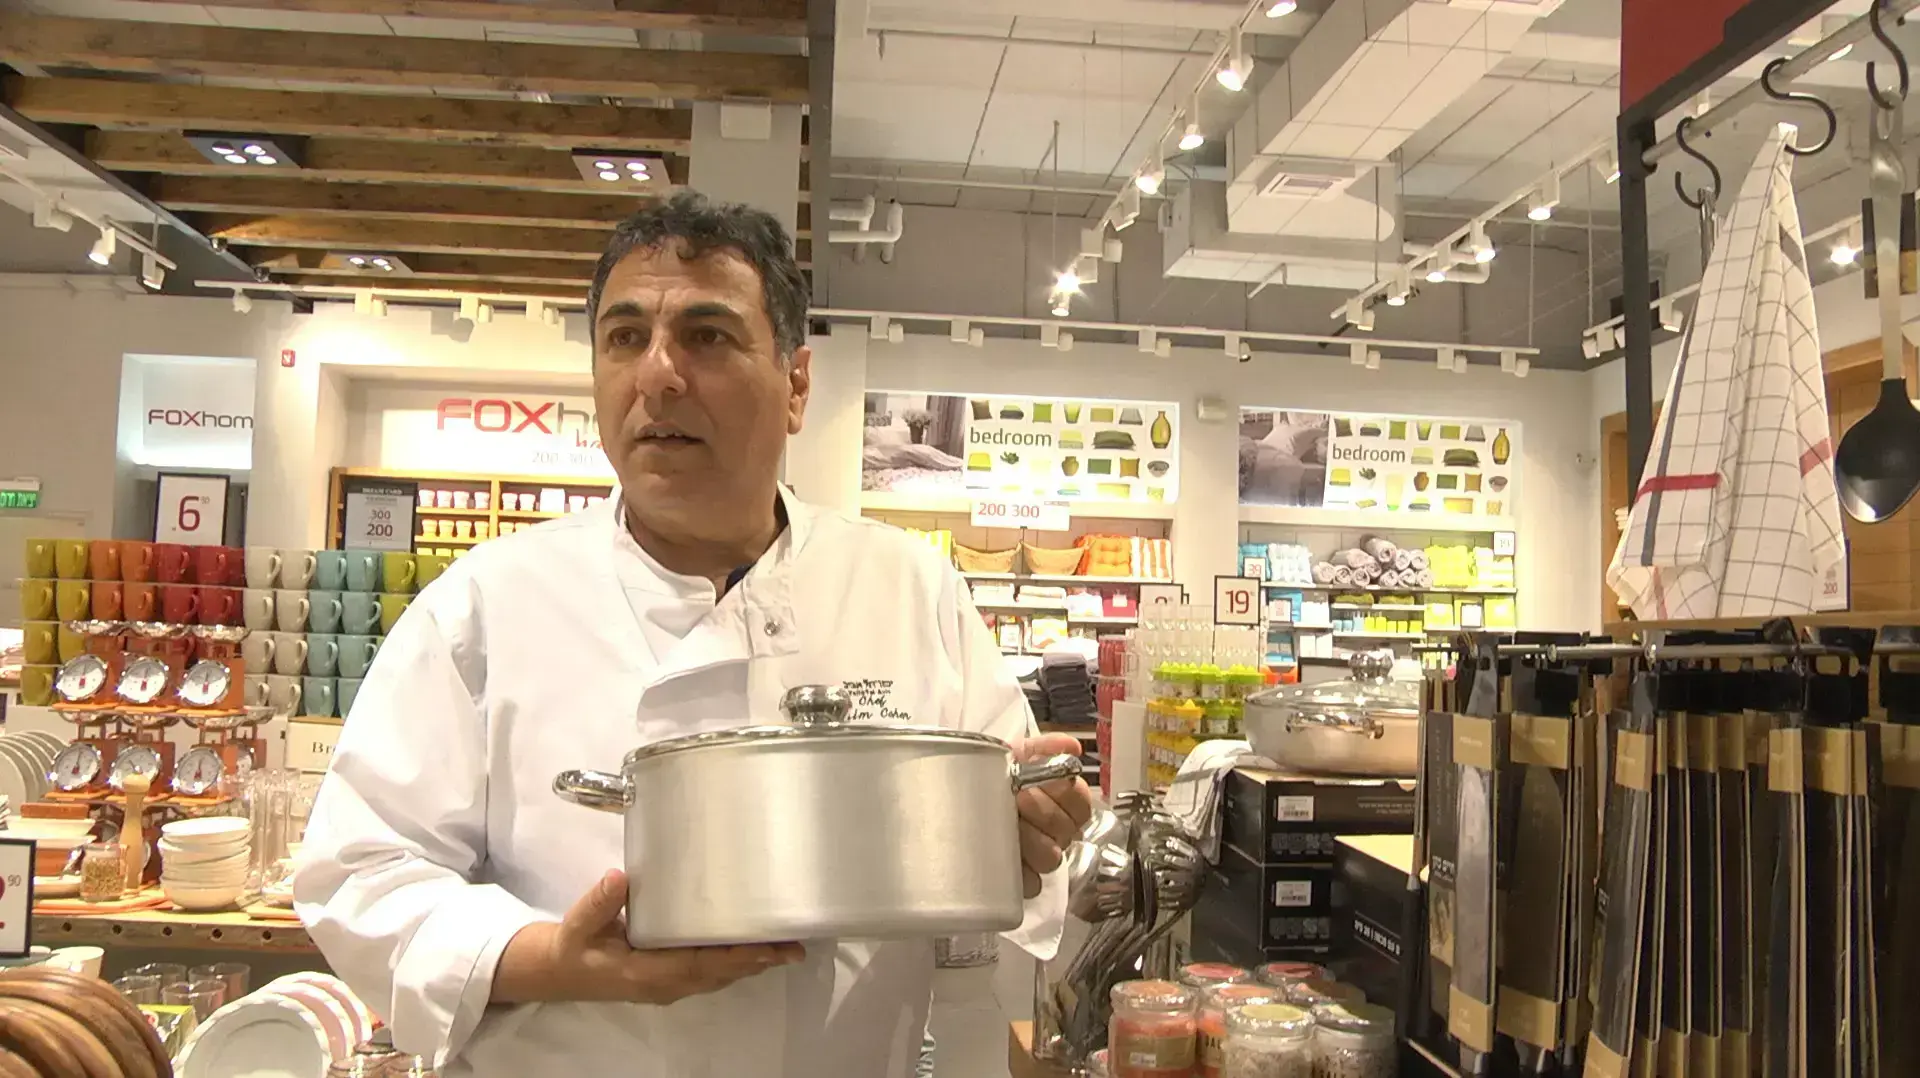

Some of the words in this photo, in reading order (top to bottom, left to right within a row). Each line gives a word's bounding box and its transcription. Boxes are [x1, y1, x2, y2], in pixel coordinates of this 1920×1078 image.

[148, 409, 254, 428] FOXhom
[437, 398, 600, 434] FOXh
[970, 427, 1052, 447] bedroom
[1332, 443, 1405, 463] bedroom
[178, 495, 200, 531] 6
[978, 502, 1007, 517] 200
[1012, 504, 1040, 519] 300
[366, 523, 393, 537] 200
[1225, 590, 1250, 614] 19
[7, 875, 21, 887] 90
